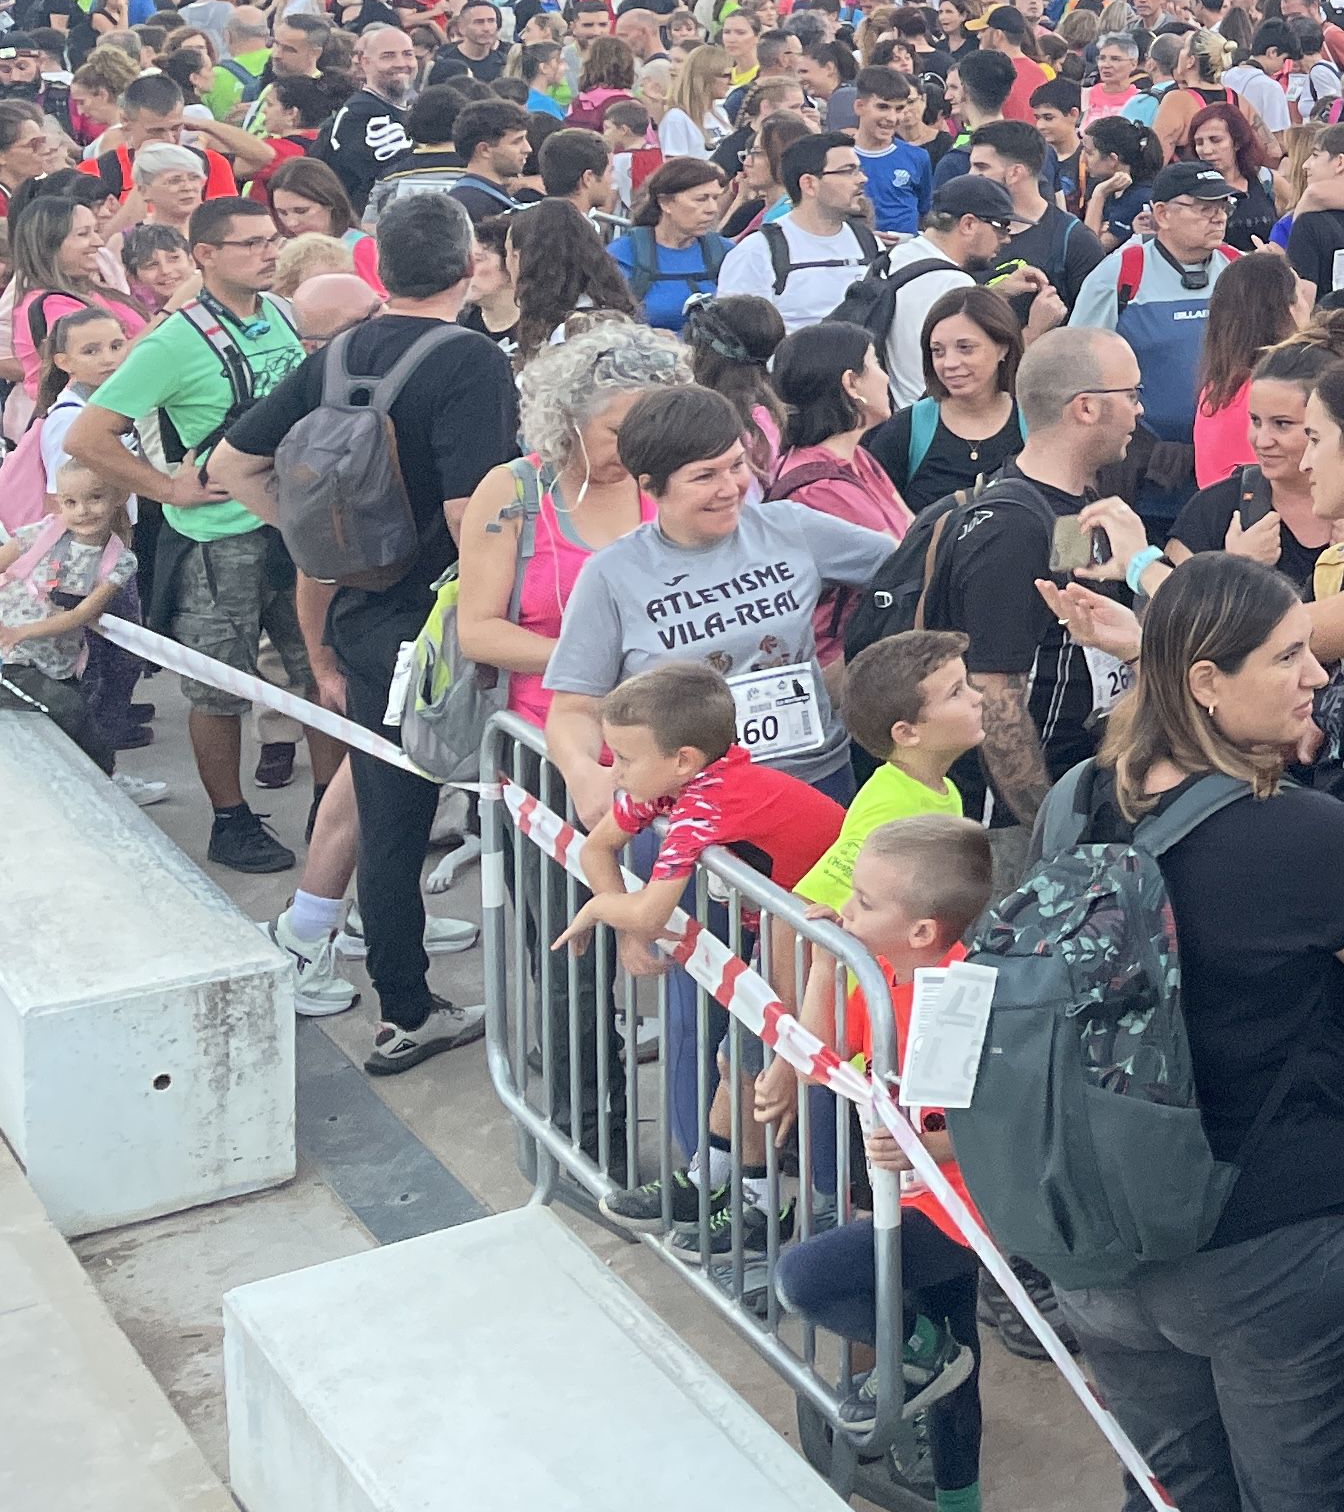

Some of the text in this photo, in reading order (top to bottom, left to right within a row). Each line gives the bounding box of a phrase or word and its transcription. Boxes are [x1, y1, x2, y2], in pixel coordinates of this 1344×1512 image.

[646, 561, 795, 623] ATLETISME
[657, 589, 800, 650] VILA-REAL
[737, 715, 779, 745] 60
